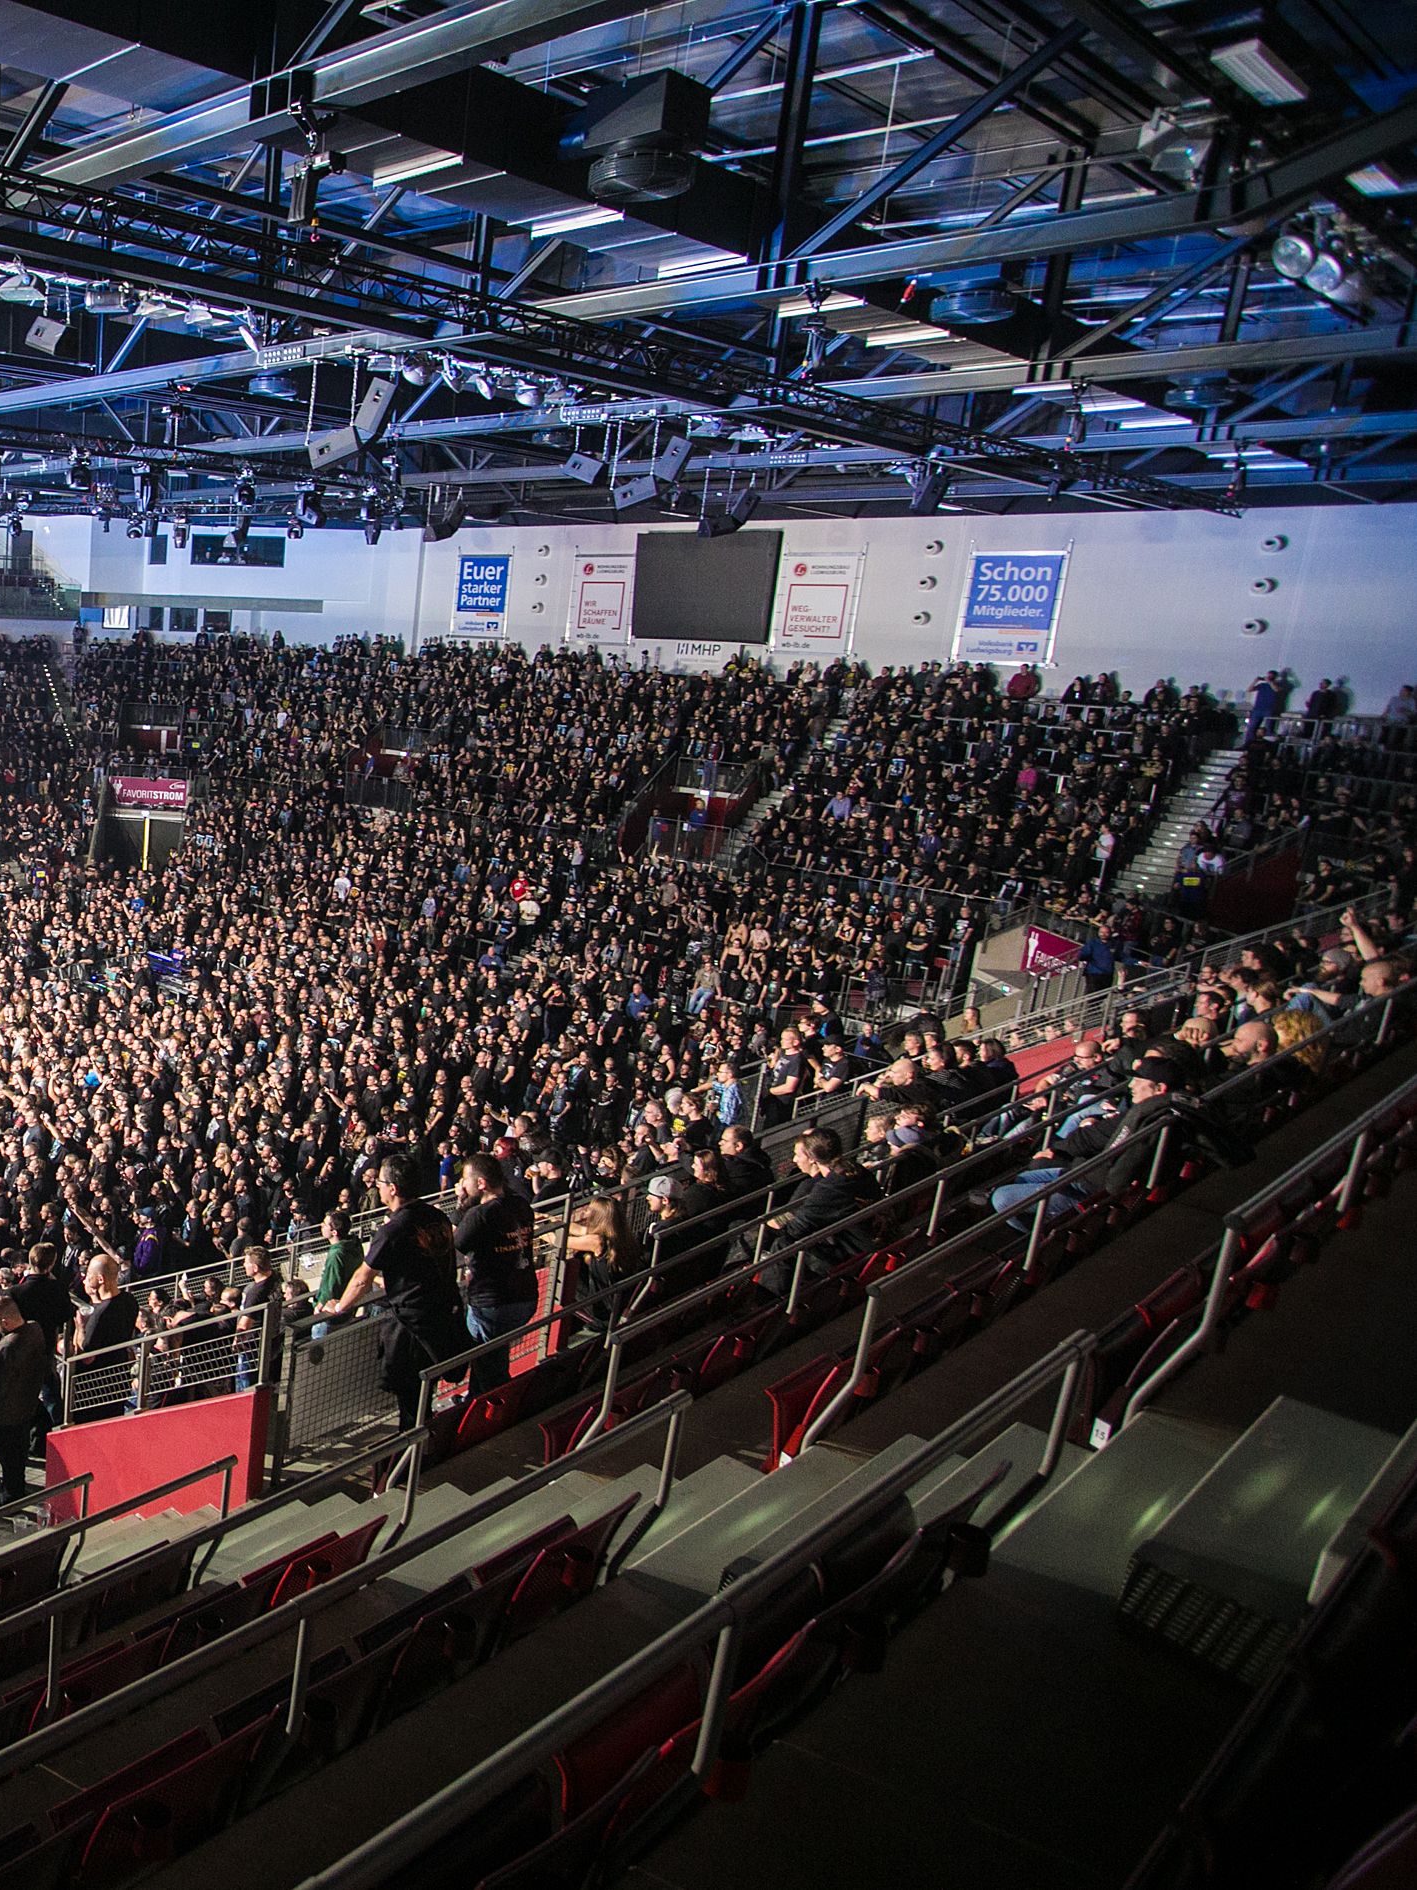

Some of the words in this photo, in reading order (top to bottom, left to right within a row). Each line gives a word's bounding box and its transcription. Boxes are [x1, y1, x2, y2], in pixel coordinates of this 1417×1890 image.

[462, 561, 505, 580] Euer
[978, 560, 1053, 582] Schon
[461, 581, 503, 595] starker
[976, 584, 1050, 603] 75.000
[460, 594, 502, 607] Partner
[583, 609, 618, 617] SCHAFFEN
[791, 605, 812, 613] WEG-
[972, 604, 1045, 620] Mitglieder.
[582, 617, 606, 625] RÄUME
[789, 615, 838, 624] VERWALTER
[787, 624, 831, 633] GESUCHT?
[690, 643, 722, 656] MHP
[966, 646, 1013, 656] Ludwigsburg
[122, 788, 184, 801] FAVORITSTROM
[1094, 1428, 1106, 1441] 15
